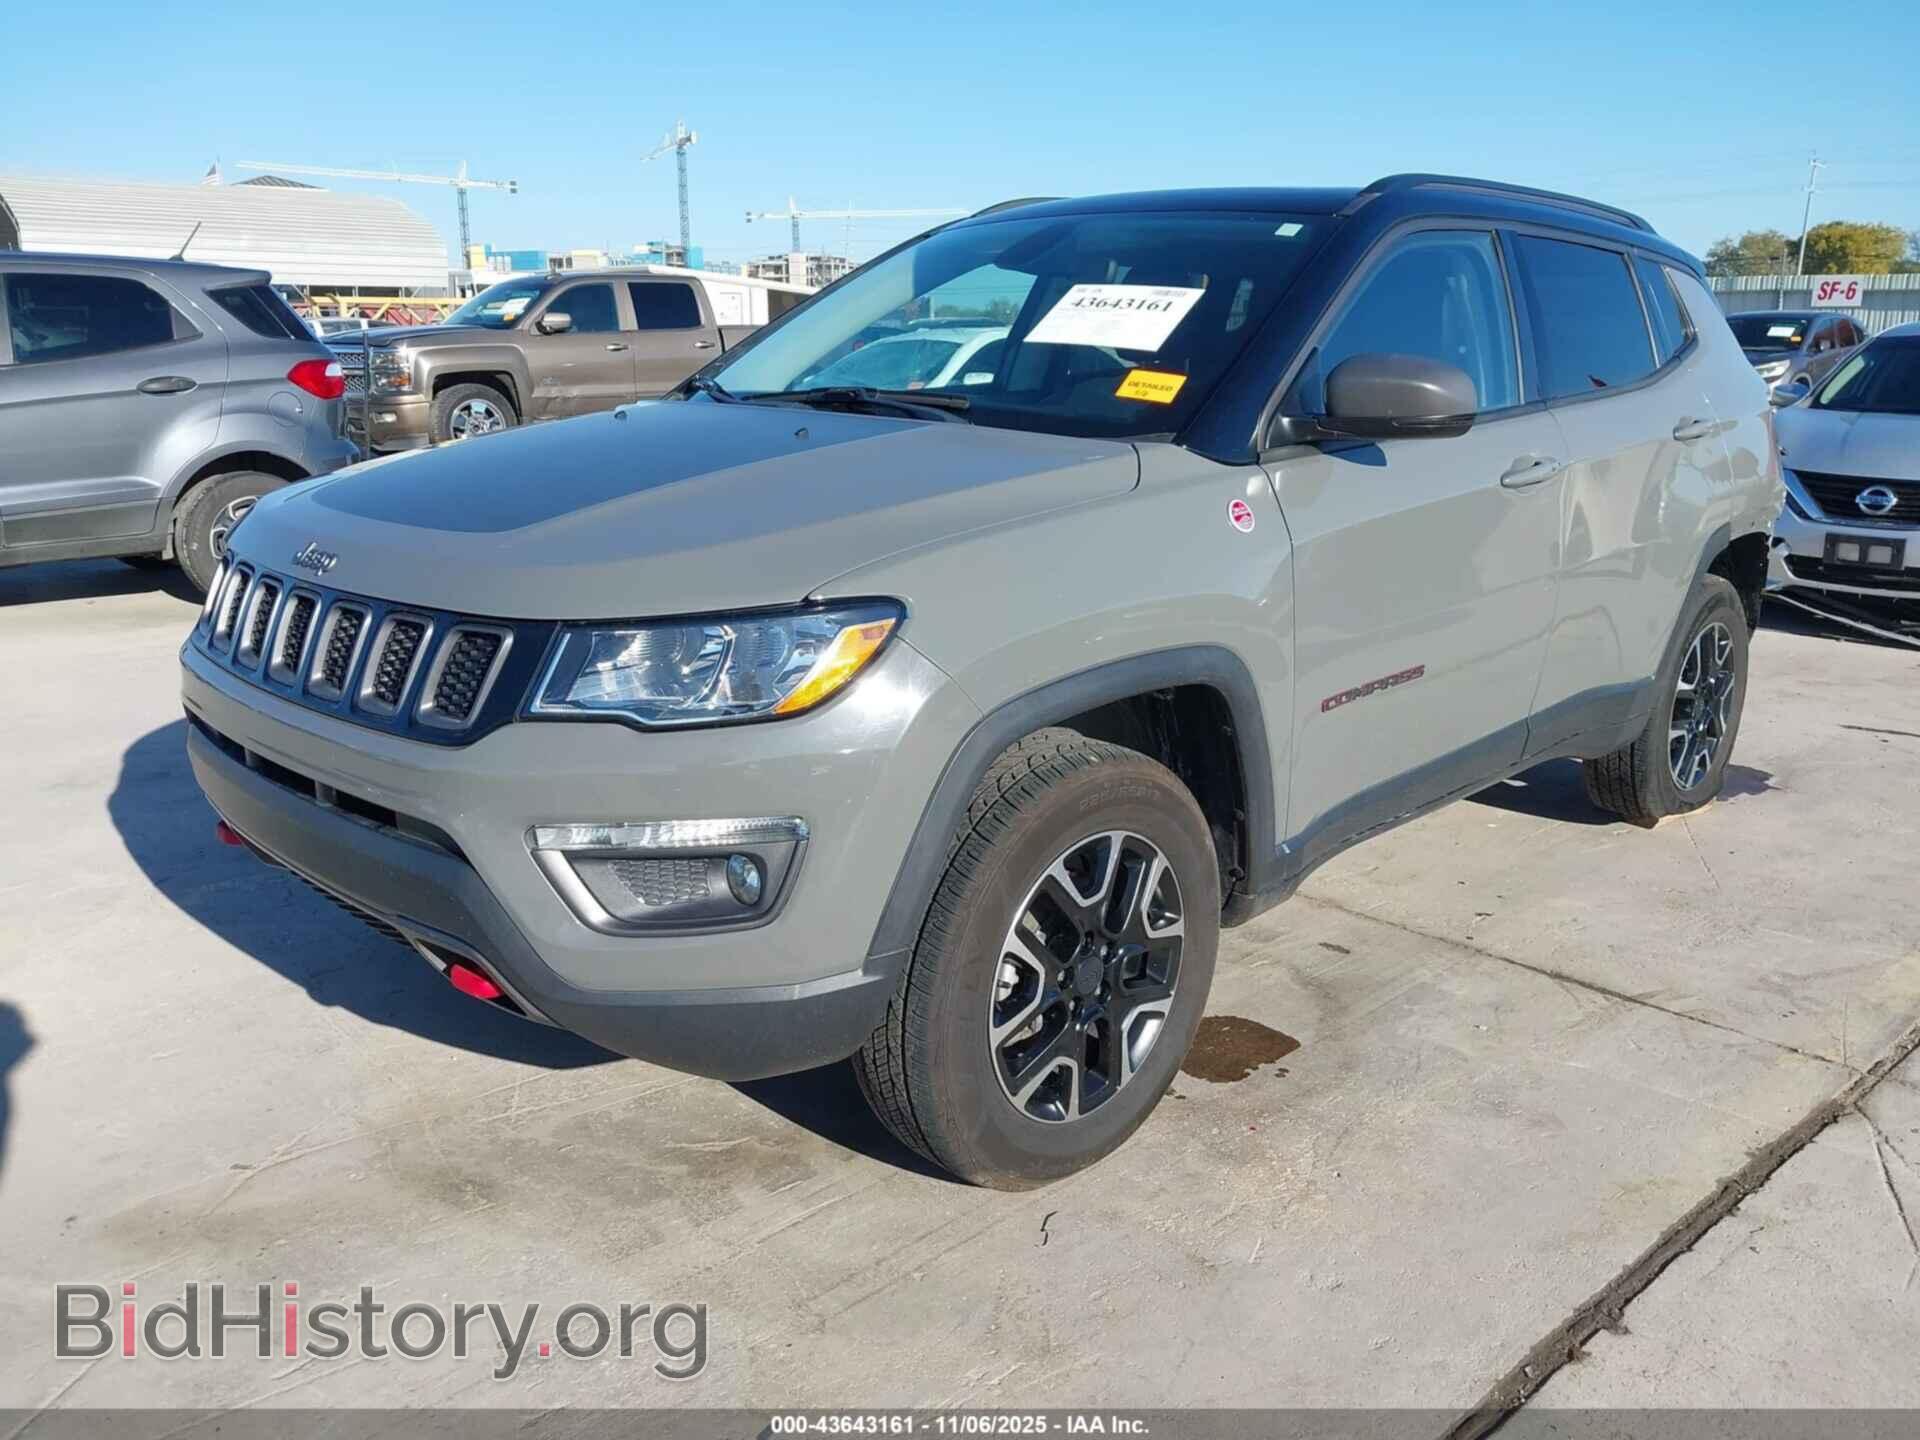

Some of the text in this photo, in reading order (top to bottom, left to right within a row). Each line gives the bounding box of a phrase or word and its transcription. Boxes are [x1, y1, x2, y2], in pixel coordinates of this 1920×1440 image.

[1817, 281, 1858, 300] SF-6
[1071, 297, 1173, 313] 43643161
[294, 541, 338, 577] Jeep
[1321, 664, 1425, 713] COMPASS
